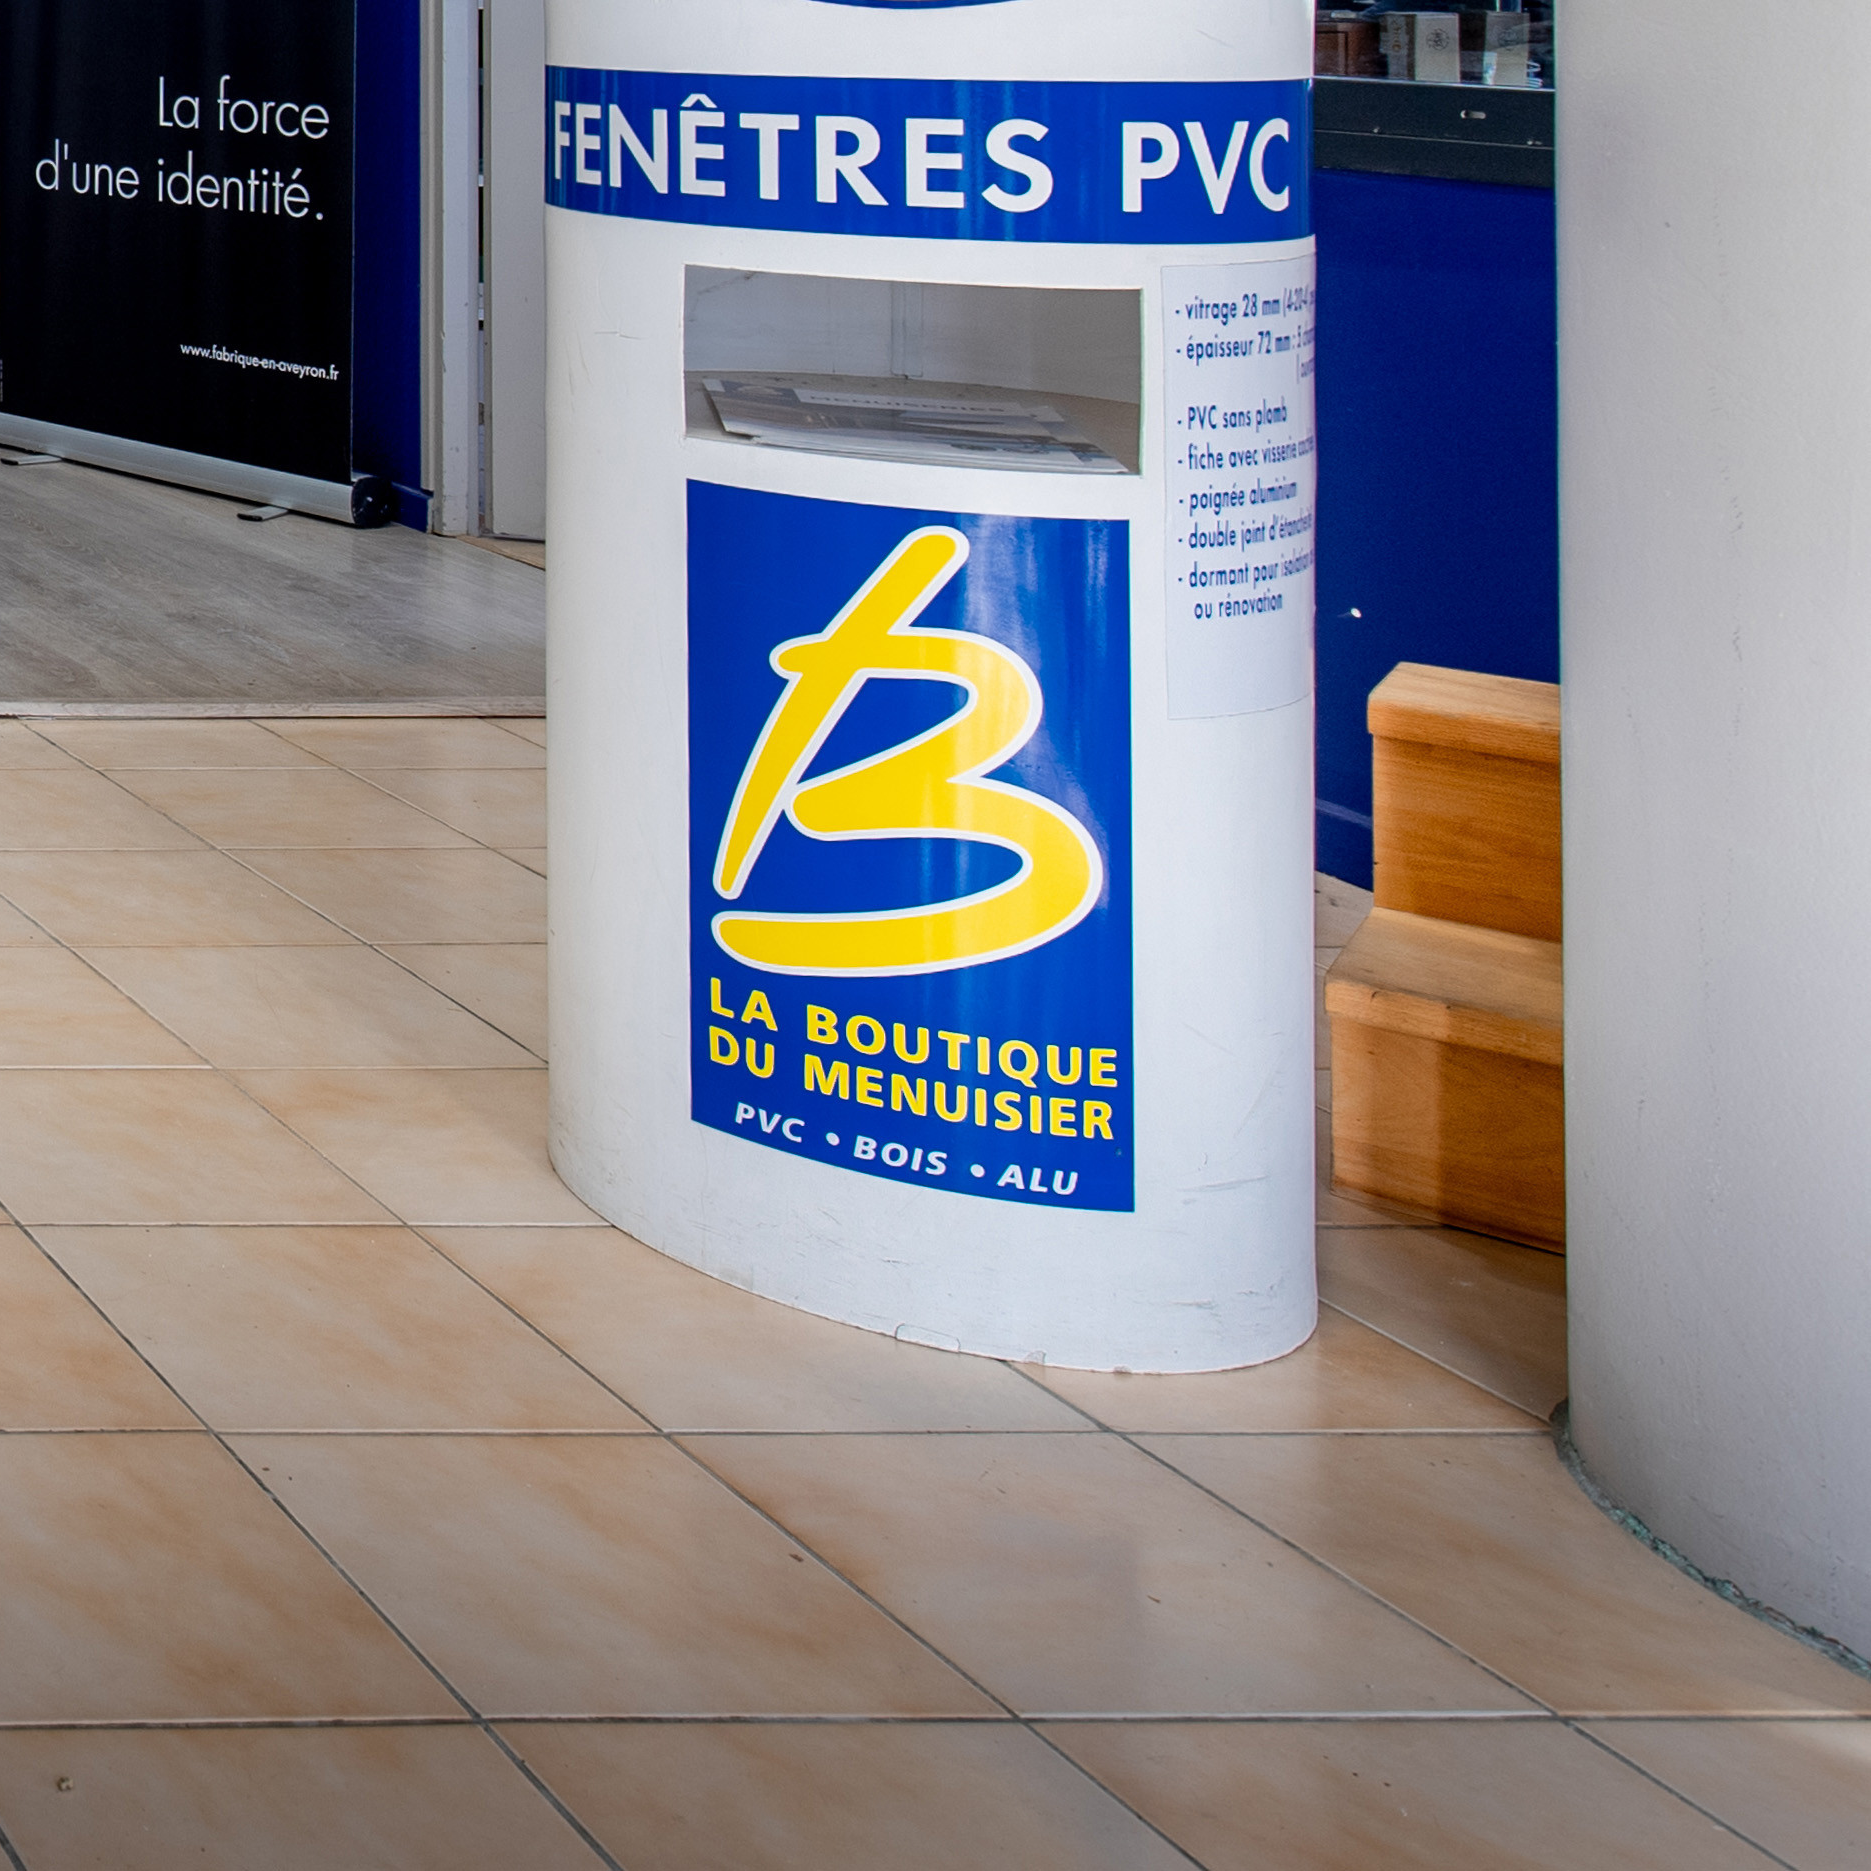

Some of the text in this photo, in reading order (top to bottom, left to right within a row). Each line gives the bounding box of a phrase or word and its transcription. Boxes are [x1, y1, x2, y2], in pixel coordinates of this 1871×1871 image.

[158, 74, 330, 140] La force
[553, 94, 1291, 215] FENÊTRES PVC
[35, 138, 324, 221] d'une identité.
[1184, 294, 1238, 326] vitrage
[1241, 292, 1258, 318] 28
[179, 342, 340, 382] www.fabrique-en-aveyron.fr
[1186, 333, 1254, 367] épaisseur
[1257, 330, 1272, 355] 72
[1187, 395, 1288, 434] PVC sans plomb
[1188, 442, 1224, 470] fiche
[1228, 448, 1259, 469] avec
[1261, 435, 1297, 464] visserie
[1189, 475, 1297, 517] poignée aluminium
[1188, 519, 1236, 549] double
[1240, 518, 1266, 553] joint
[1188, 560, 1249, 588] dormant
[1253, 562, 1279, 590] pour
[1194, 587, 1284, 620] ou rénovation
[709, 976, 1119, 1089] LA BOUTIQUE
[708, 1025, 1115, 1141] DU MENUISIER
[734, 1101, 1080, 1196] PVC BOIS ALU
